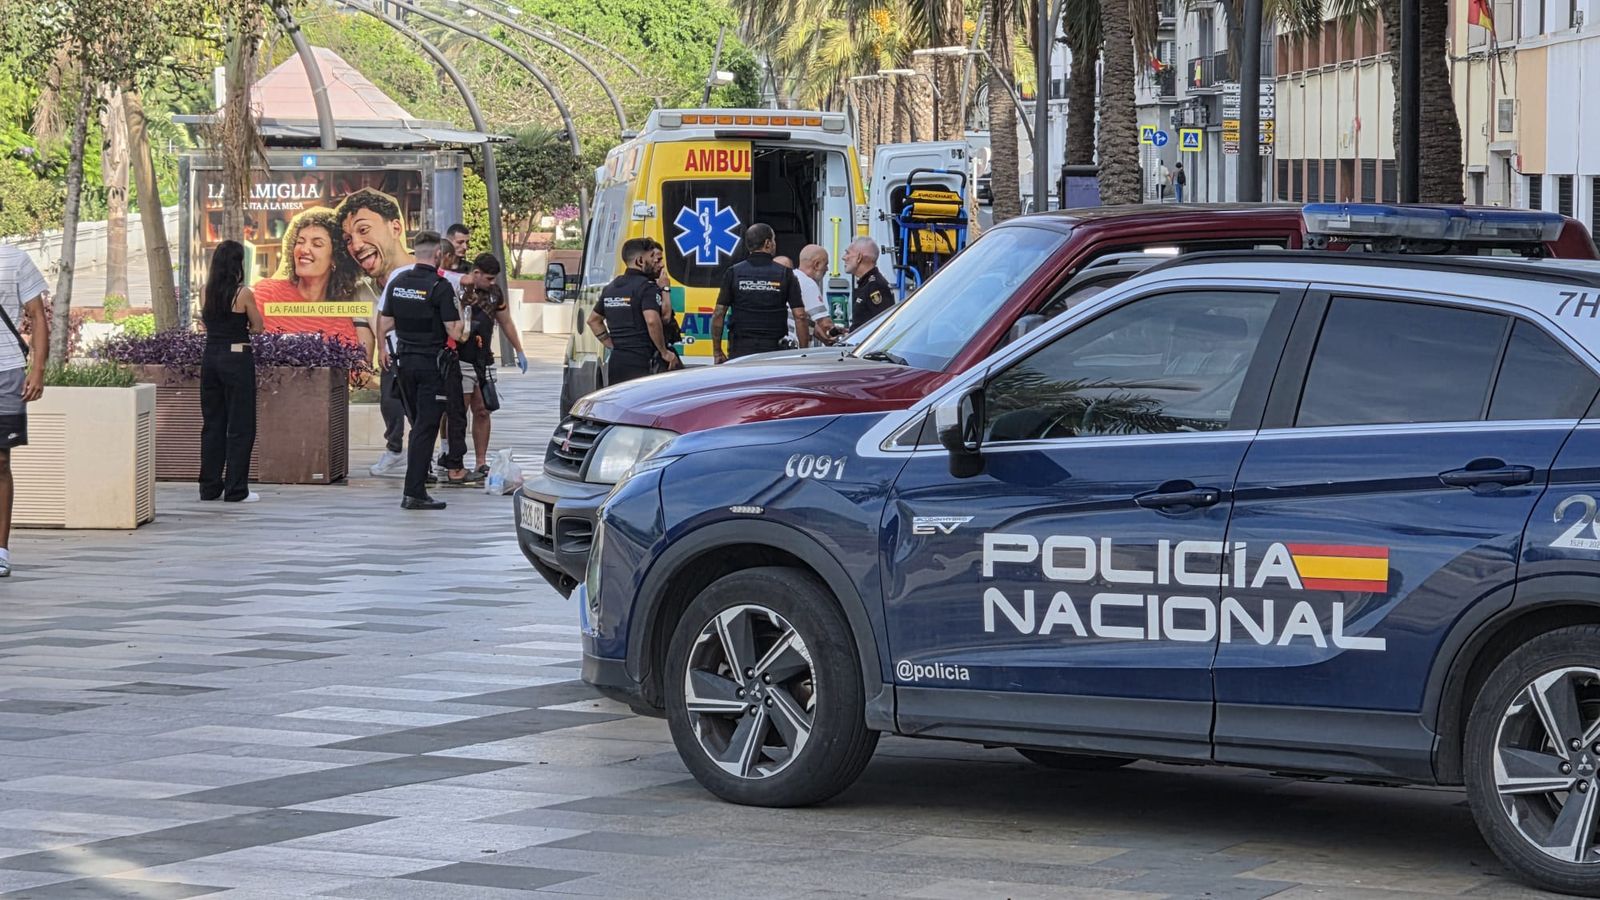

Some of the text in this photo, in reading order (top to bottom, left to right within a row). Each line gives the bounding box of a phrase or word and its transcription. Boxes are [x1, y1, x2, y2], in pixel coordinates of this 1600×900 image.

[243, 184, 321, 199] AMIGLIA
[281, 202, 304, 210] MESA
[269, 305, 370, 314] LA FAMILIA QUE ELIGES.
[983, 586, 1387, 651] NACIONAL
[896, 659, 971, 682] @policia
